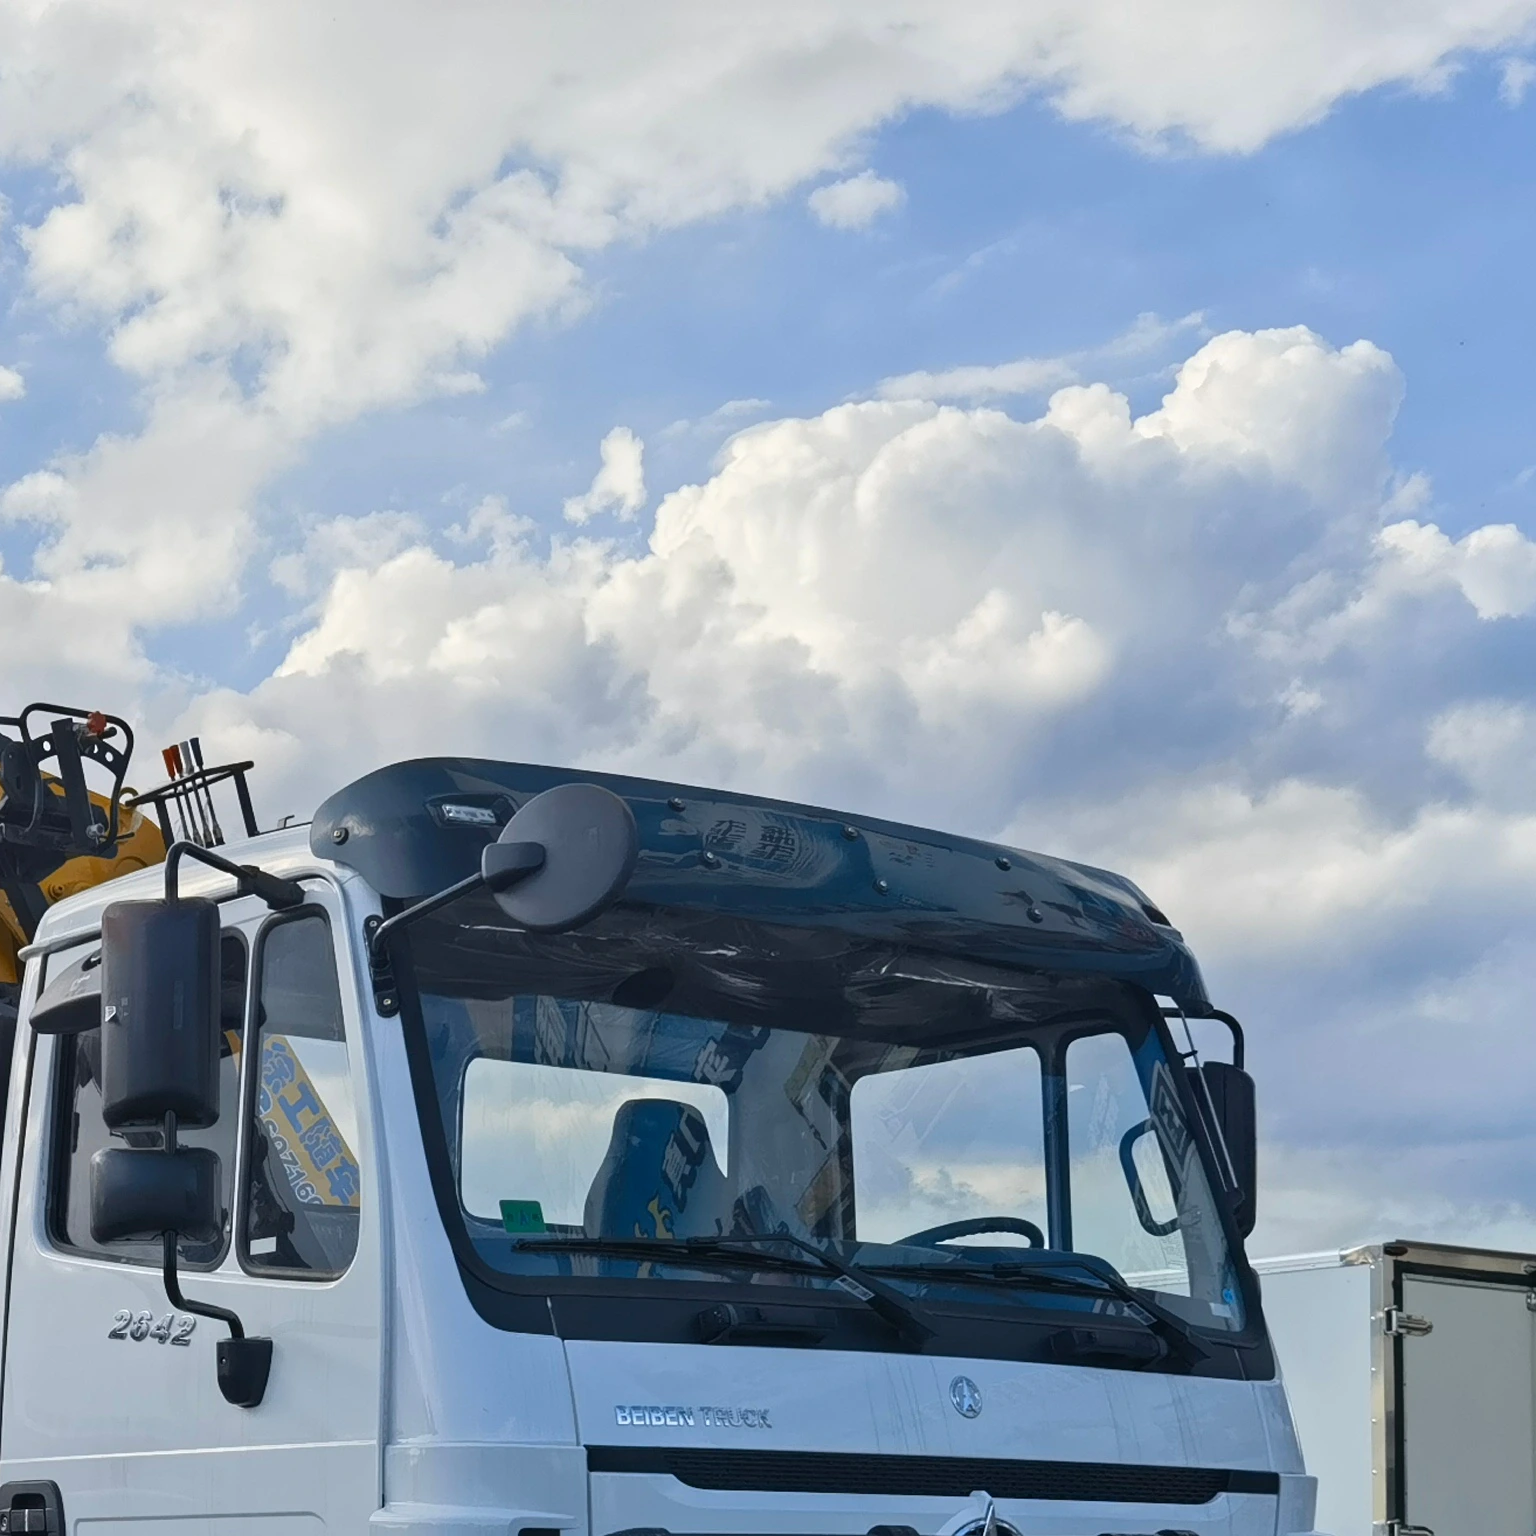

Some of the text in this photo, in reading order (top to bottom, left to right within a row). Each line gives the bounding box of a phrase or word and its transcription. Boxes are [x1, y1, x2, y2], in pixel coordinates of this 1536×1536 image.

[107, 1309, 198, 1346] 2642
[615, 1405, 773, 1429] BEIBEN TRUCK
